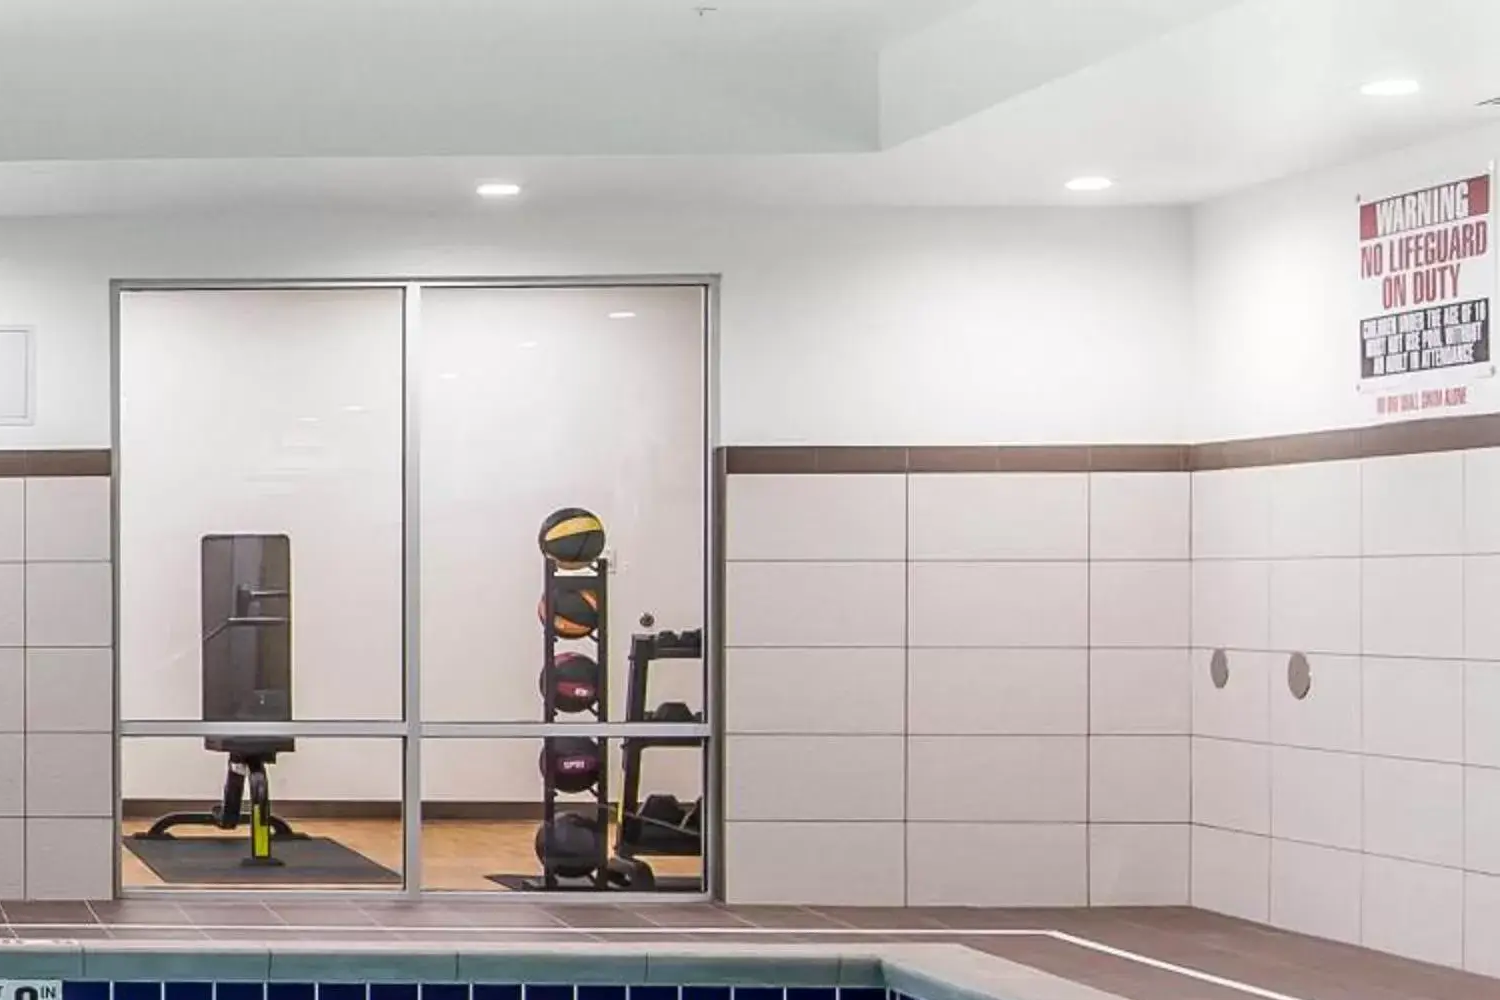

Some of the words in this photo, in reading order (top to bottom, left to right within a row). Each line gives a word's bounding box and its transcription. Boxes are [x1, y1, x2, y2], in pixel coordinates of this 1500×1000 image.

[1376, 181, 1469, 238] WARNING
[1361, 243, 1383, 280] NO
[1389, 220, 1487, 272] LIFEGUARD
[1383, 274, 1406, 310] ON
[1413, 263, 1460, 304] DUTY
[41, 986, 57, 999] IN
